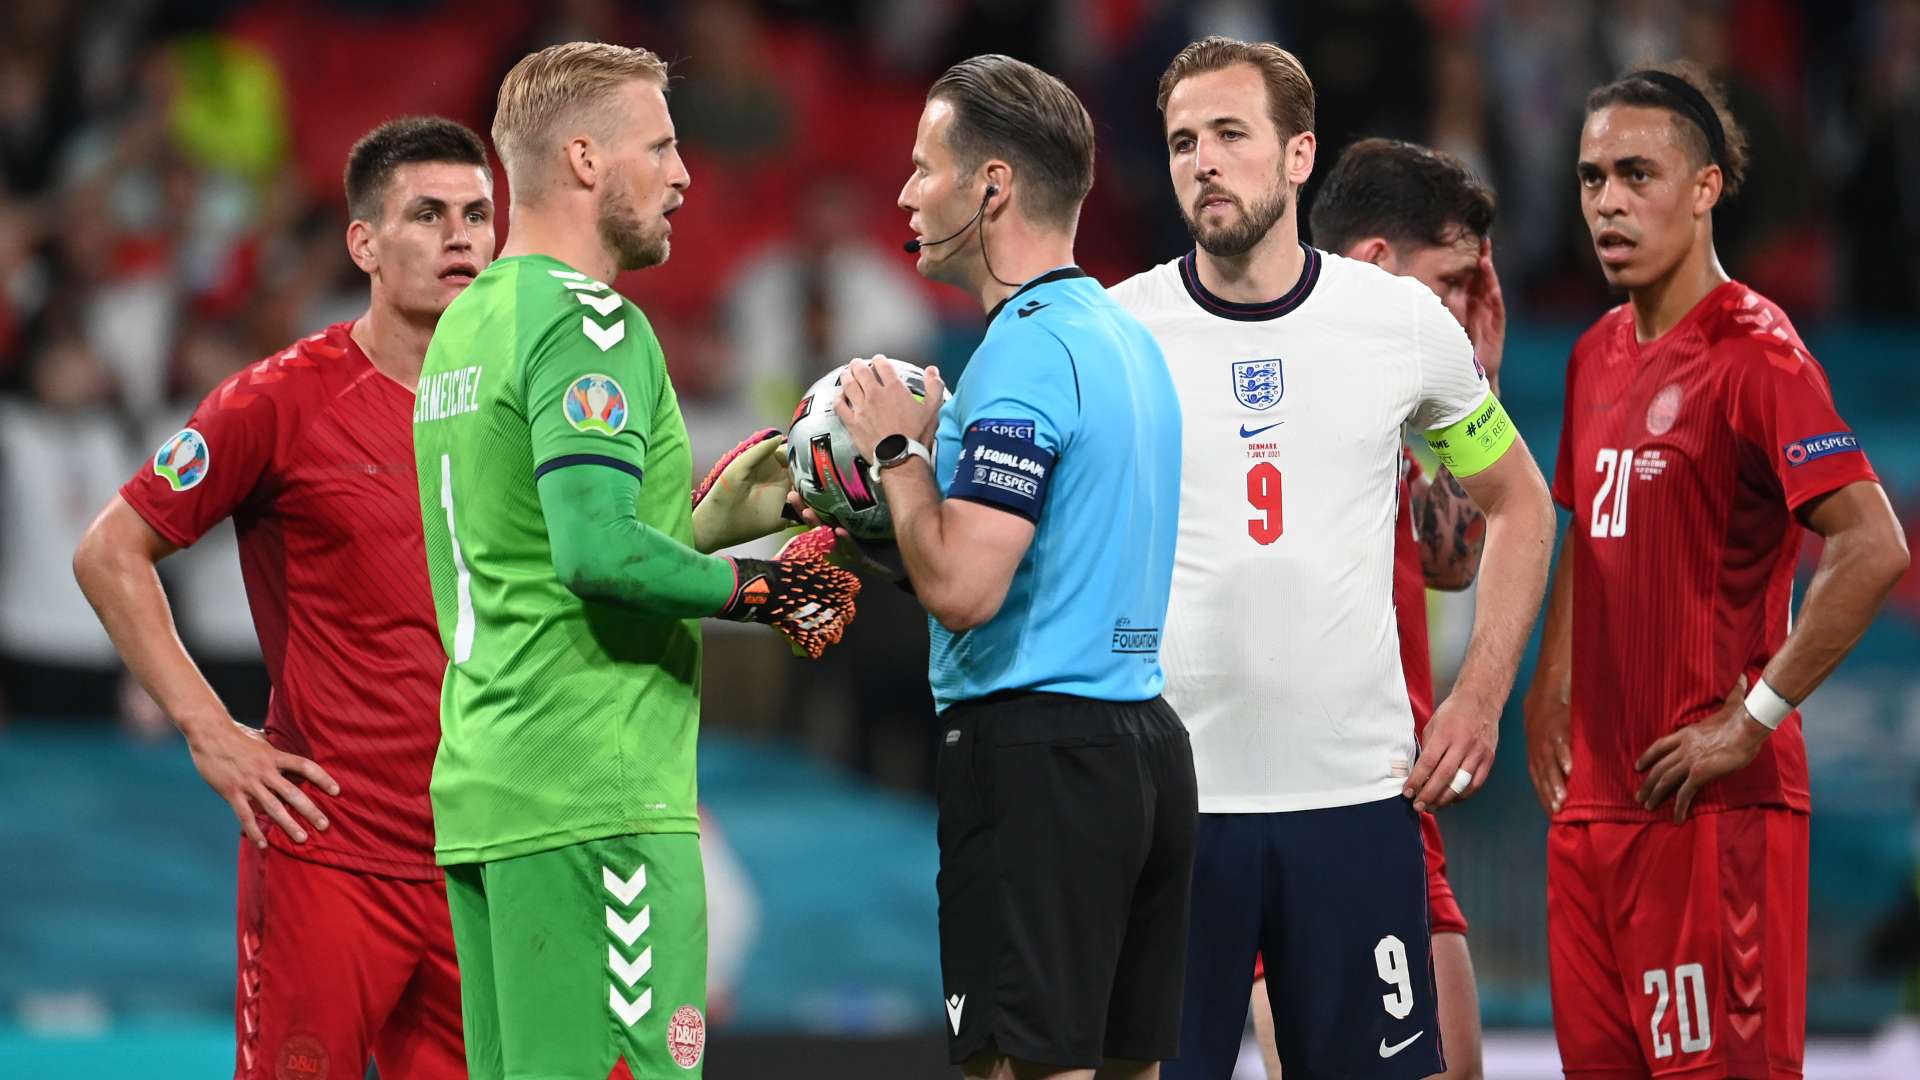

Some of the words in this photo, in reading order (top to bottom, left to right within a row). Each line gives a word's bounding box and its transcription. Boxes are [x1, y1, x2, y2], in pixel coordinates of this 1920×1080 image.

[988, 471, 1038, 496] RESPECT
[1248, 443, 1278, 451] DENMARK
[1251, 450, 1266, 458] JULY
[1806, 436, 1857, 454] RESPECT
[1246, 461, 1283, 546] 9
[1590, 448, 1634, 538] 20
[440, 454, 476, 665] 1
[1374, 934, 1414, 1020] 9
[1643, 963, 1712, 1059] 20
